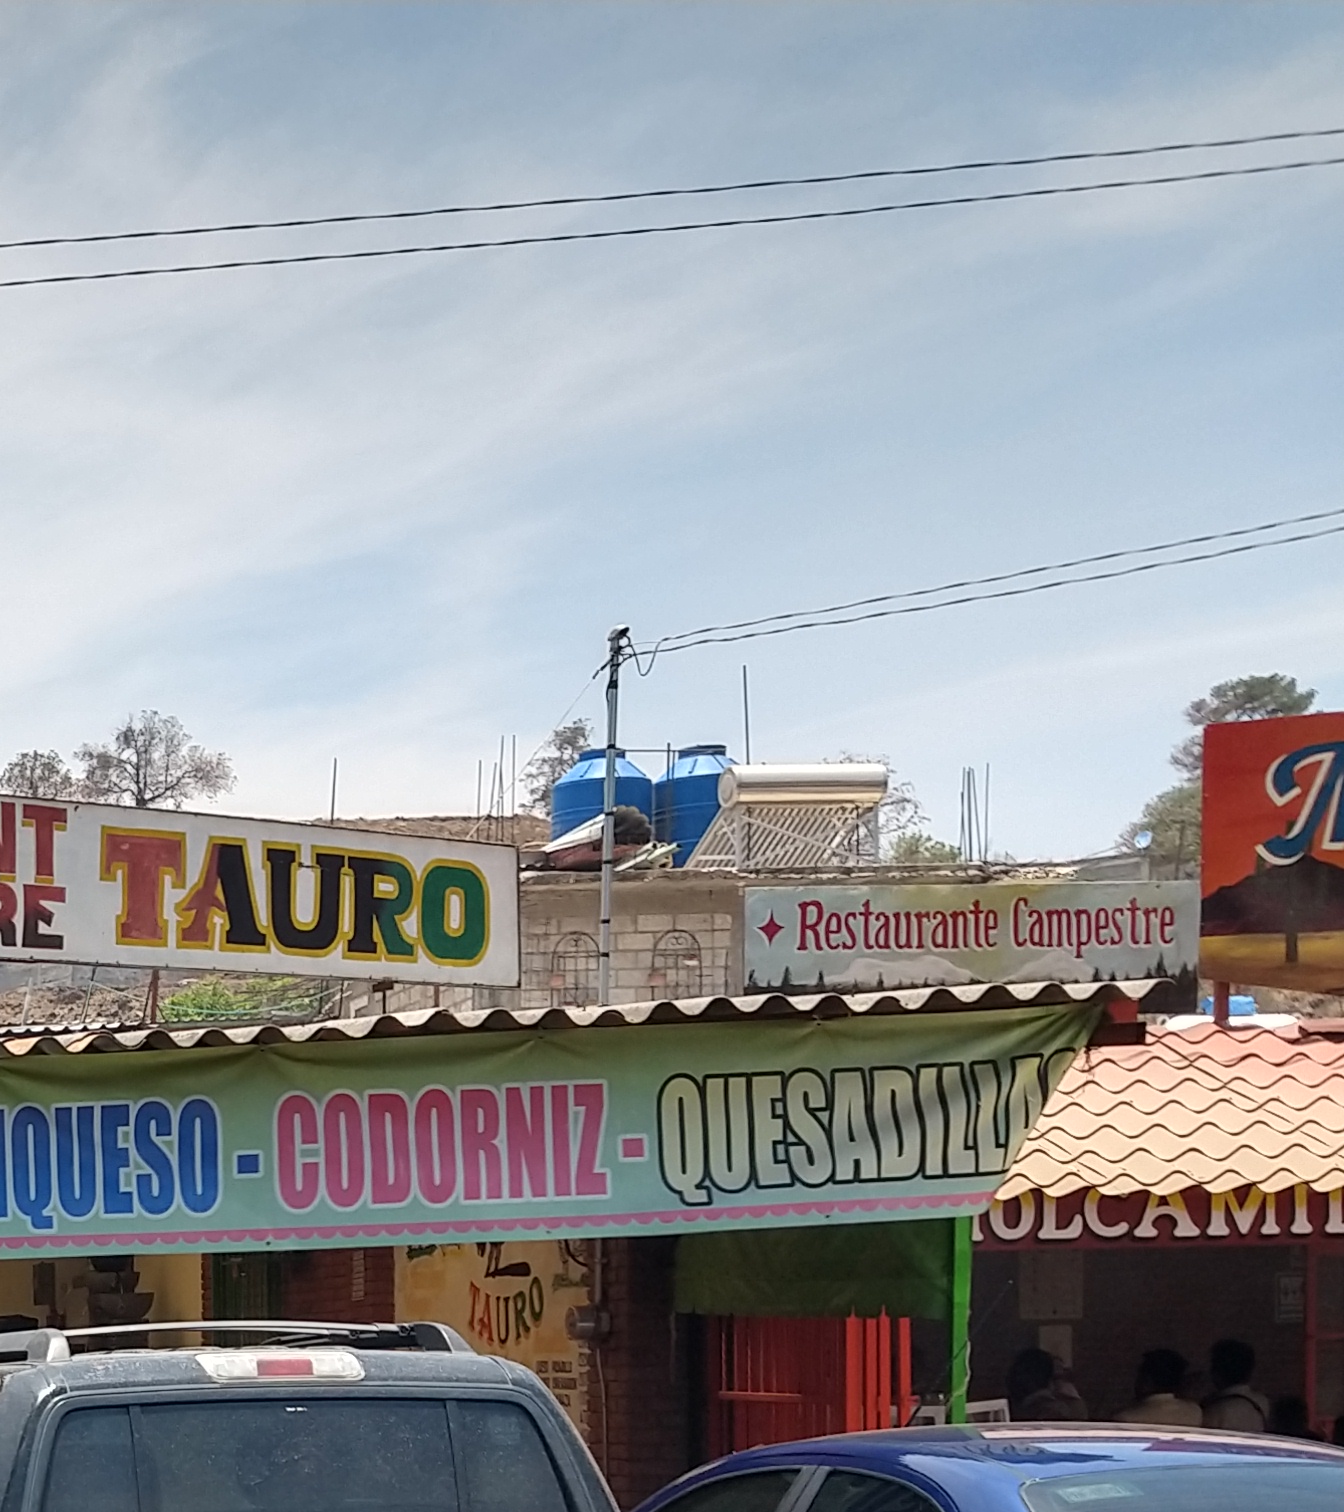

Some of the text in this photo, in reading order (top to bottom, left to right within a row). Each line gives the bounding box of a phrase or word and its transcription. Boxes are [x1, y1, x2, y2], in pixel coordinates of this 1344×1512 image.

[100, 824, 490, 968] TAURO
[796, 897, 1176, 959] Restaurante Campestre
[274, 1082, 608, 1212] CODORNIZ
[971, 1183, 1344, 1242] OLCAMI
[469, 1275, 544, 1348] TAURO
